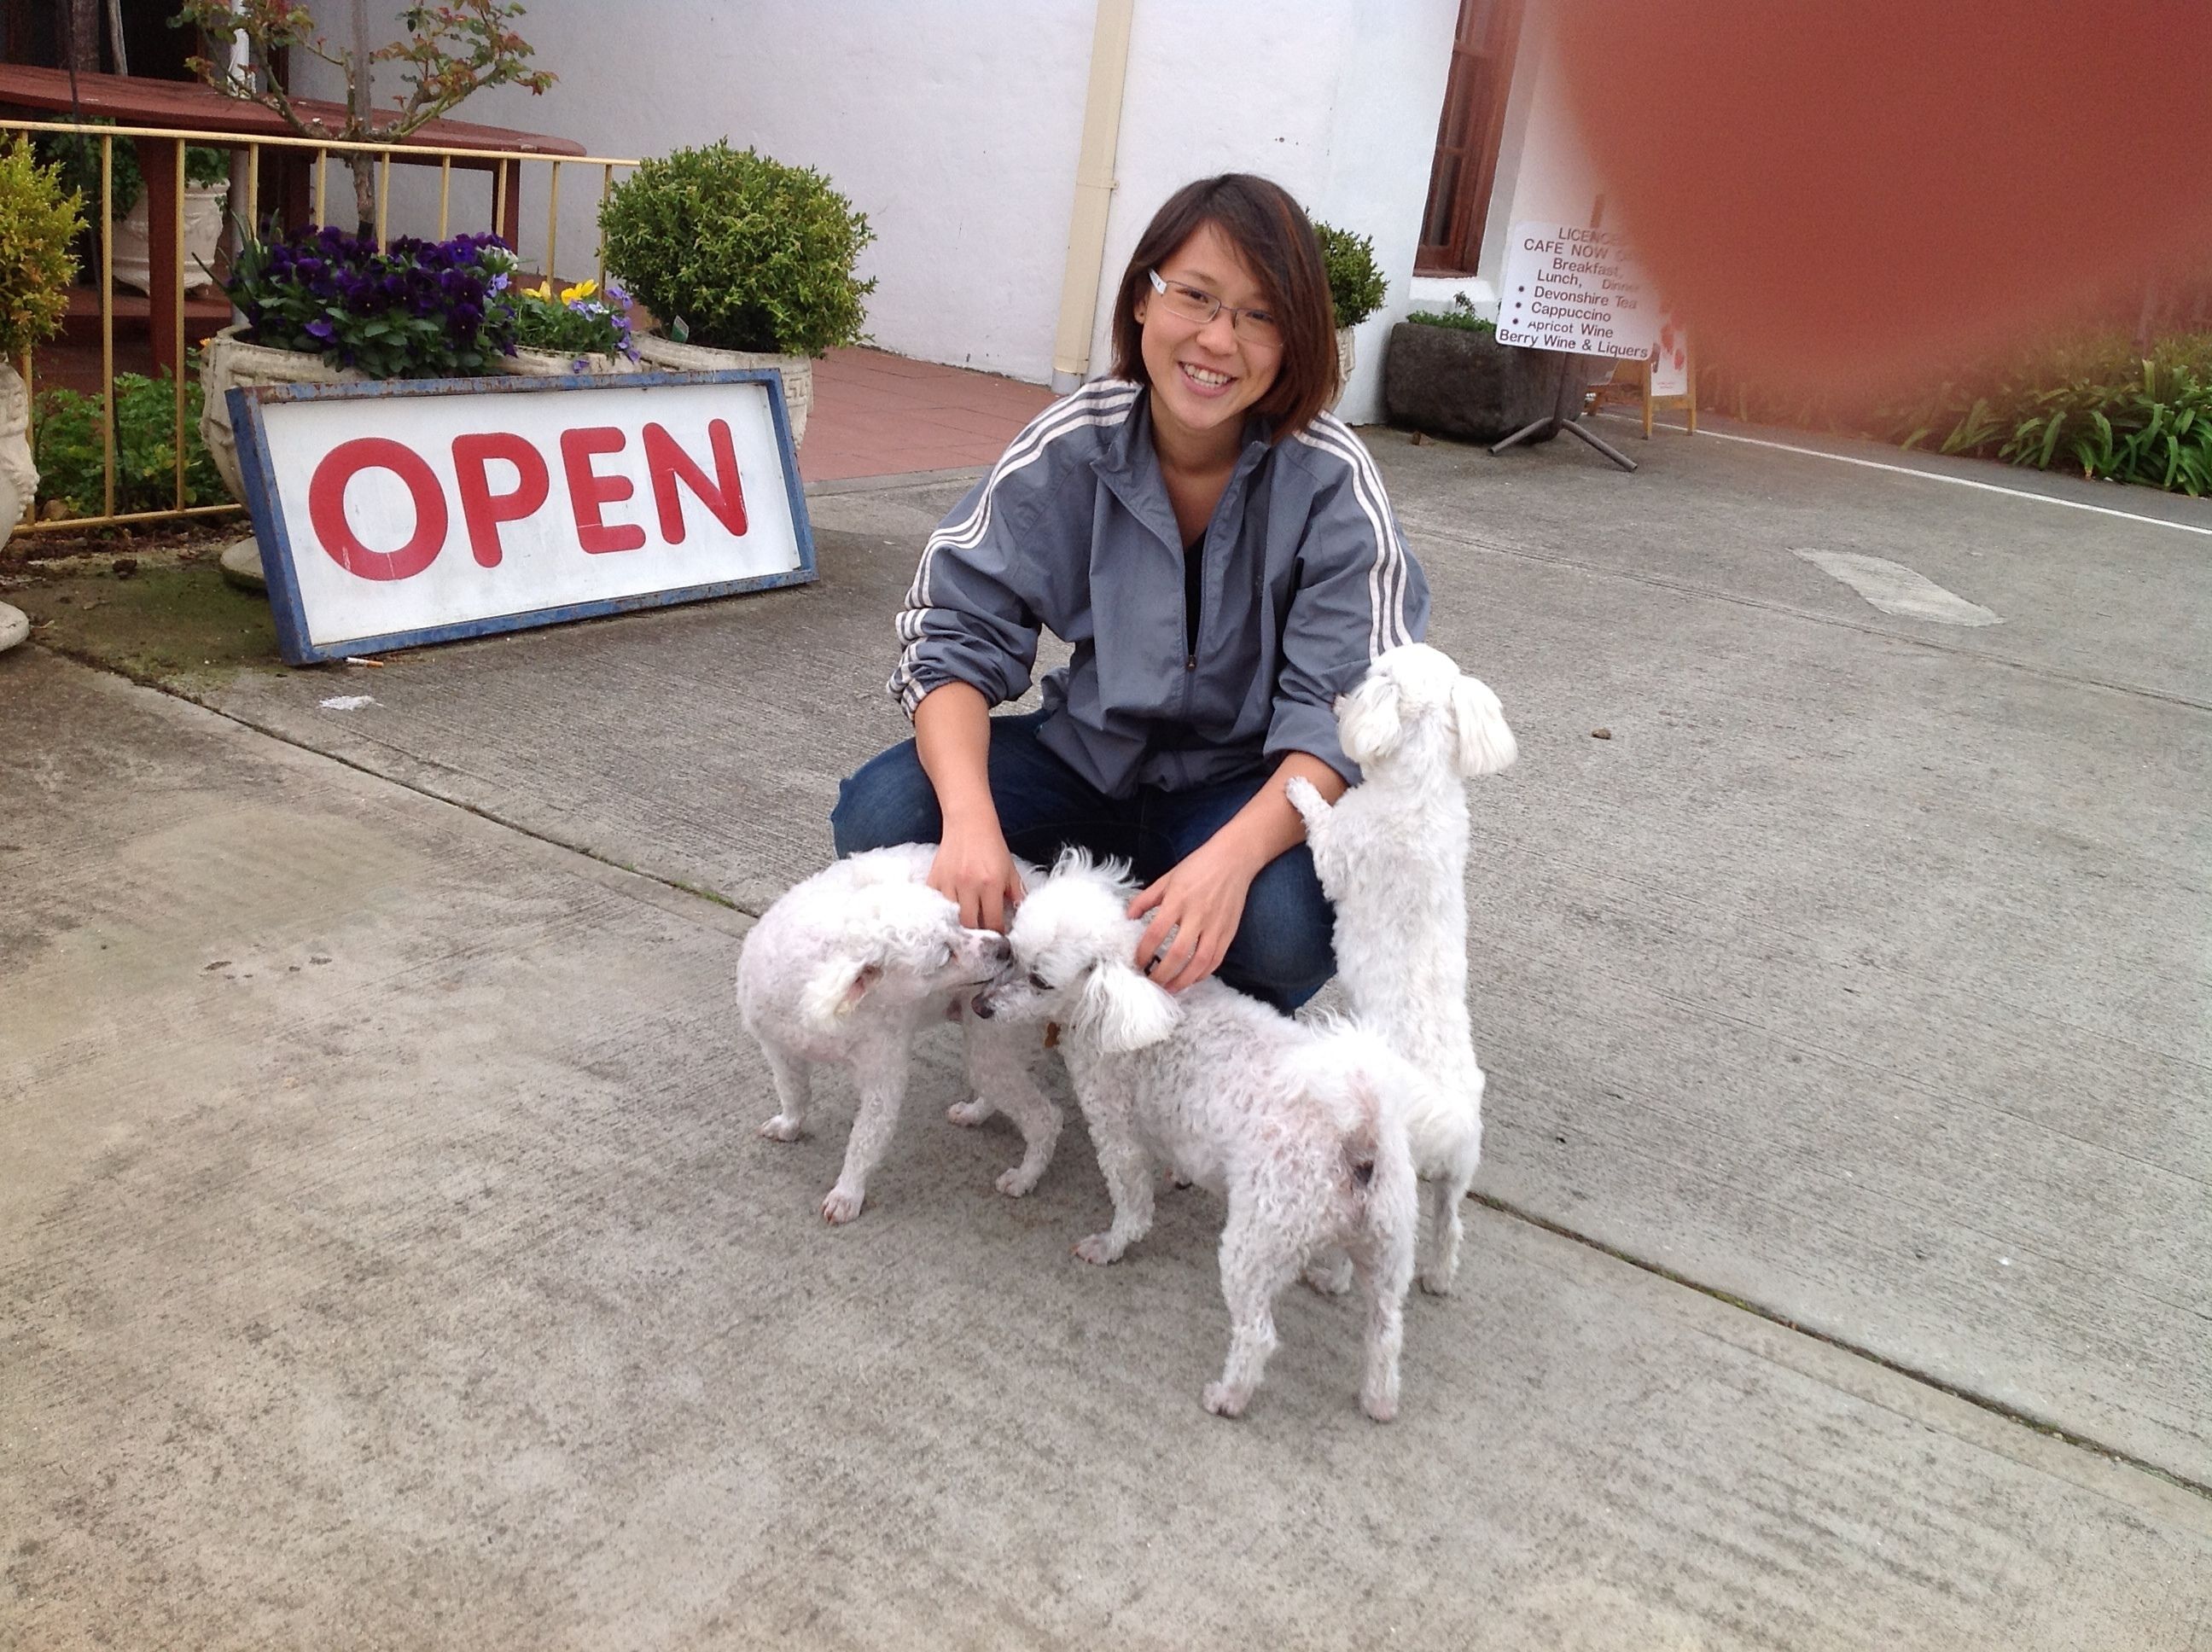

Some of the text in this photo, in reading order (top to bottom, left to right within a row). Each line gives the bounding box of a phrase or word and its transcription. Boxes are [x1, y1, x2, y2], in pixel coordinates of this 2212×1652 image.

[1558, 227, 1627, 247] LICENC
[1523, 238, 1564, 255] CAFE
[1571, 244, 1609, 259] NOW
[1537, 270, 1582, 288] Lunch,
[1534, 286, 1638, 310] Devonshire Tea
[1531, 301, 1611, 323] Cappuccino
[1527, 321, 1614, 339] Apricot Wine
[1499, 329, 1649, 358] Berry Wine & Liquers
[308, 418, 748, 581] OPEN
